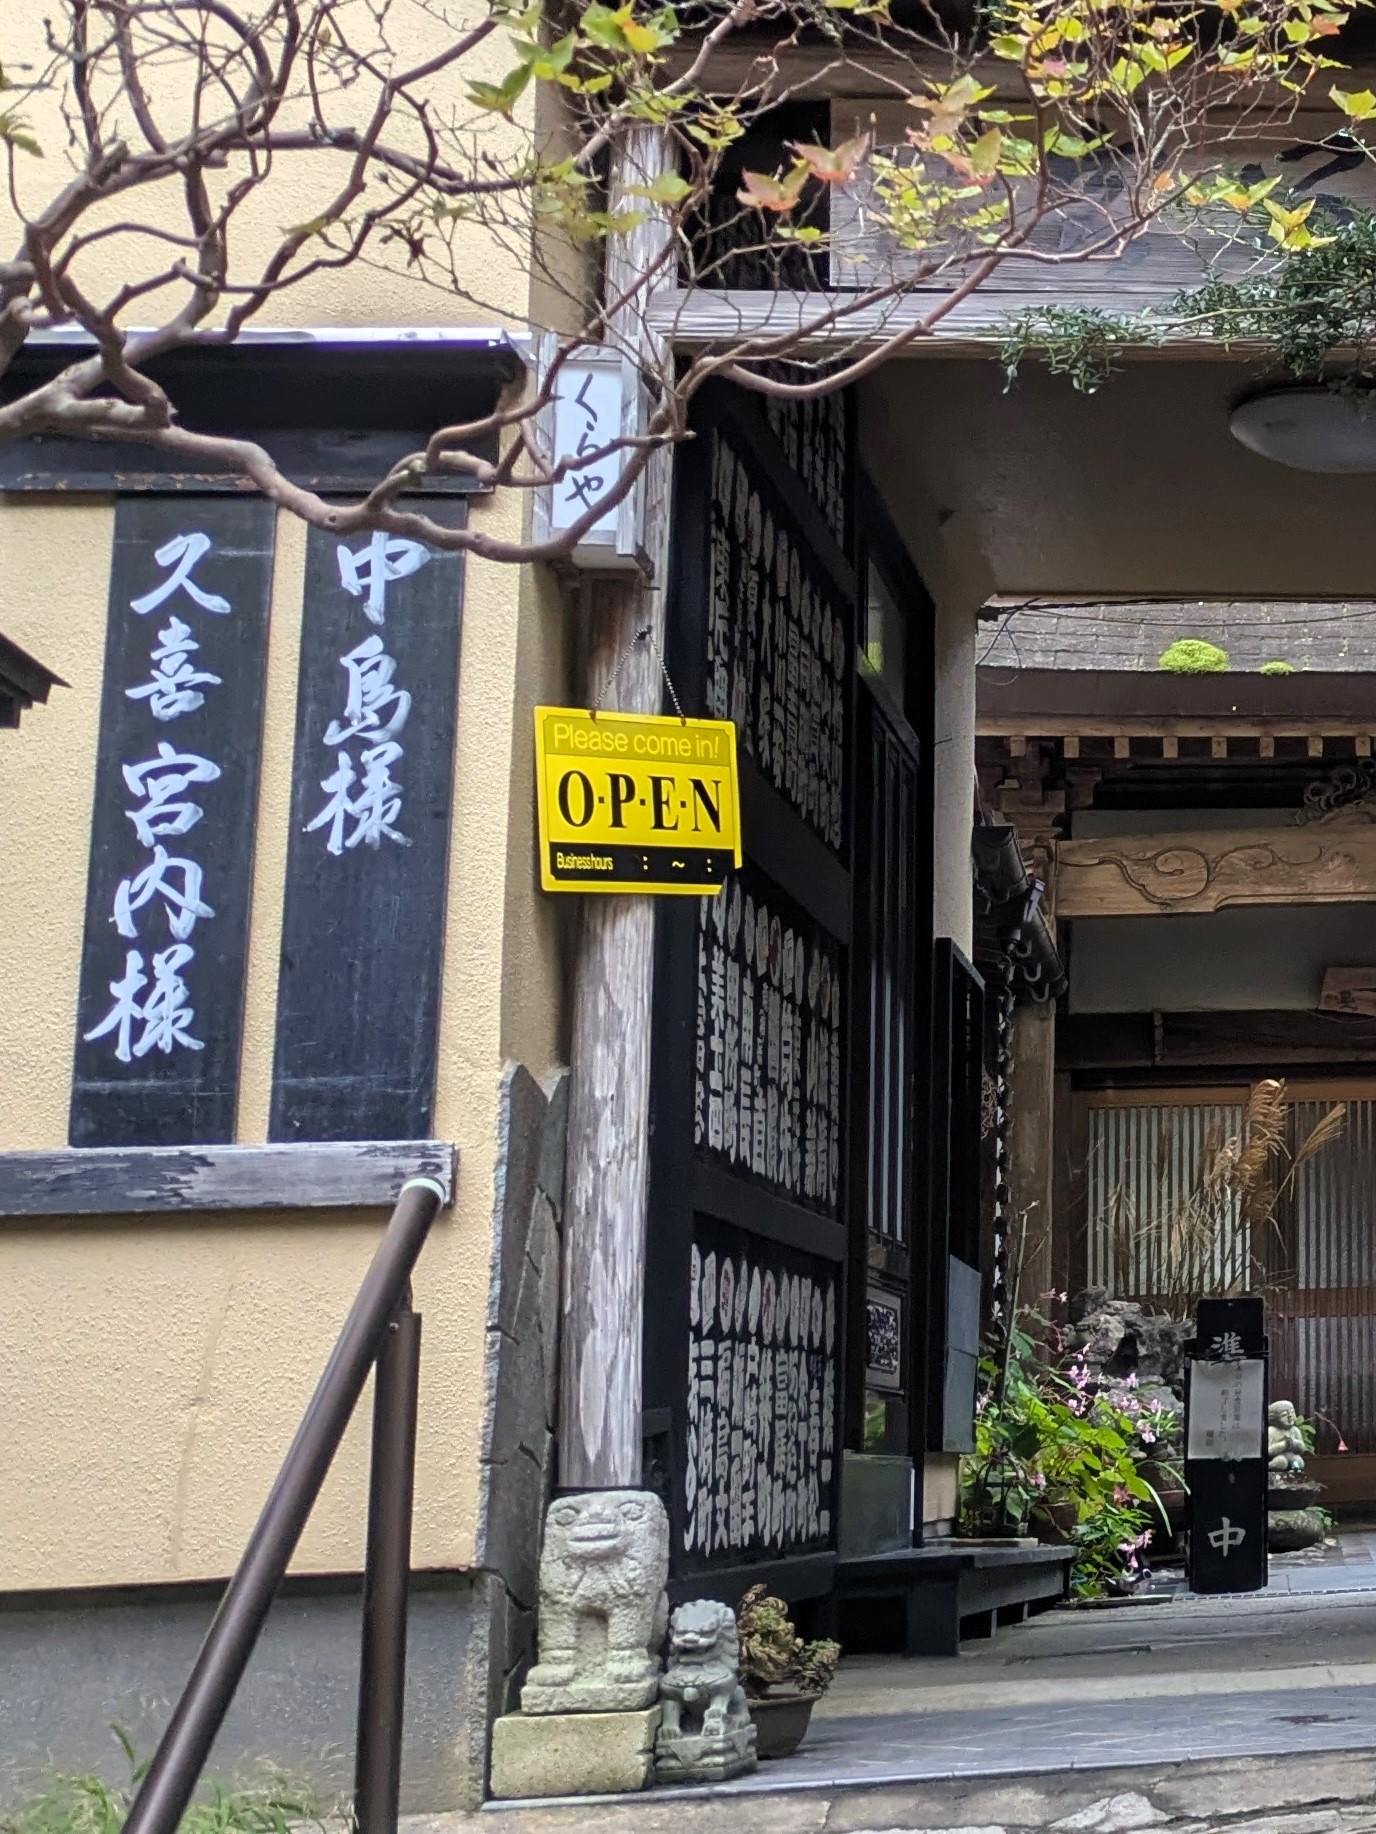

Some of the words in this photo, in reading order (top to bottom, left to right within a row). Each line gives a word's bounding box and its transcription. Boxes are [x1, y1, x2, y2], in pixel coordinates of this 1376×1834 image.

[303, 530, 431, 856] 中島様
[553, 723, 629, 752] Please
[633, 734, 692, 757] come
[695, 734, 720, 759] in!
